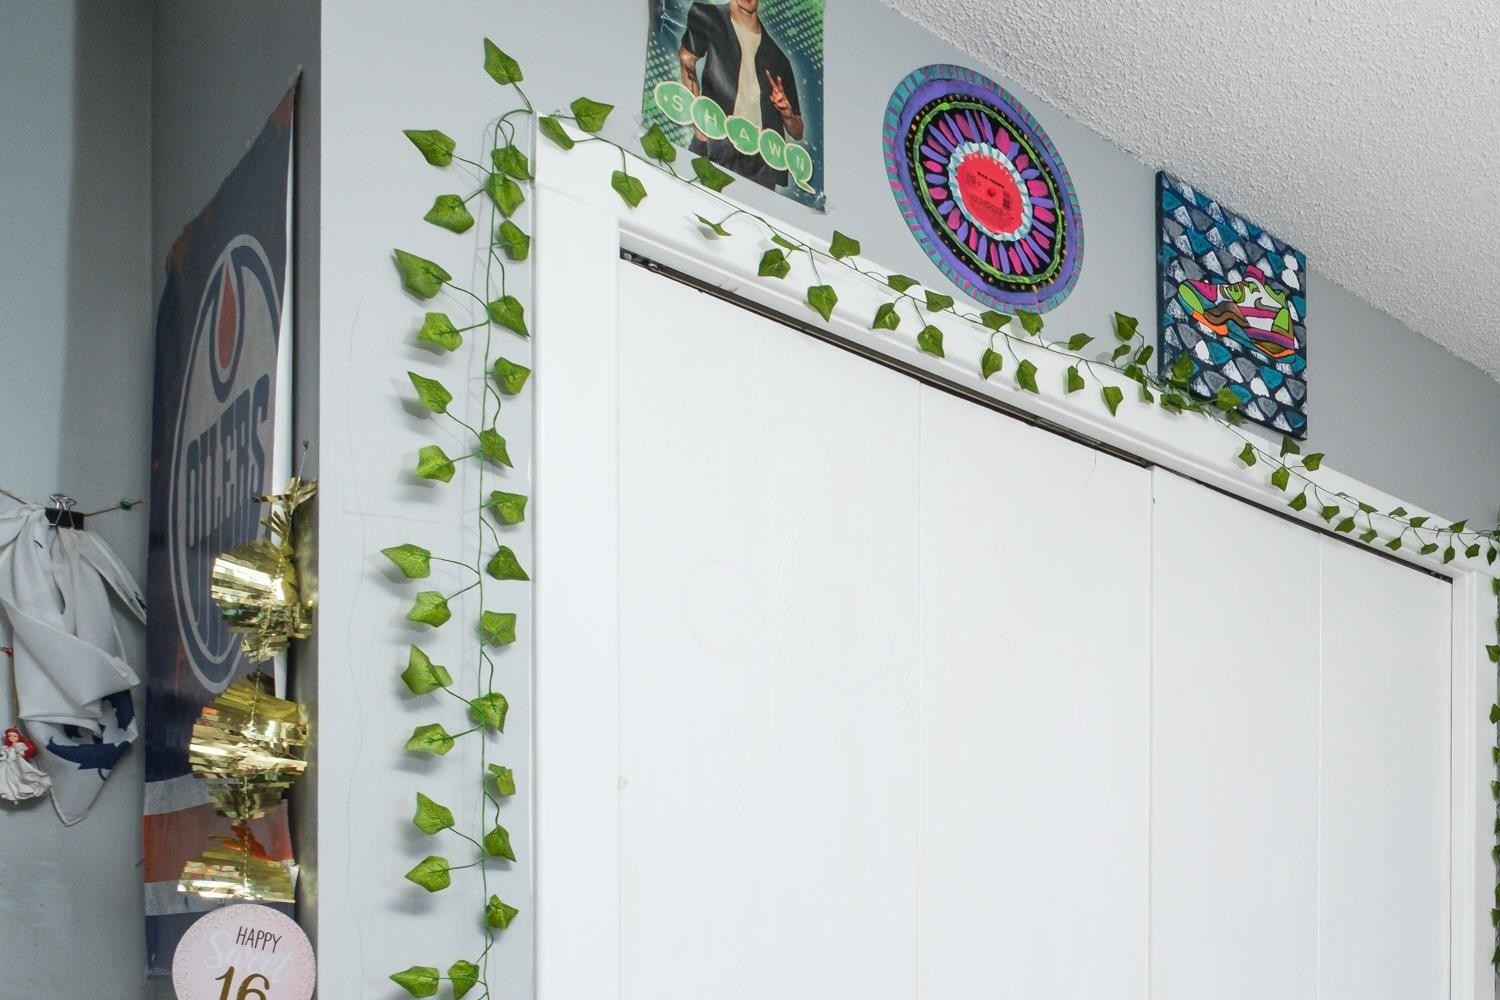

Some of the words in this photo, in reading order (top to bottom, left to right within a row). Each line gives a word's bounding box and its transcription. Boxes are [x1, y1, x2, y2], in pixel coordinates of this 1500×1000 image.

[671, 94, 806, 172] SHAWN
[186, 372, 272, 550] OILERS
[235, 925, 283, 954] HAPPY
